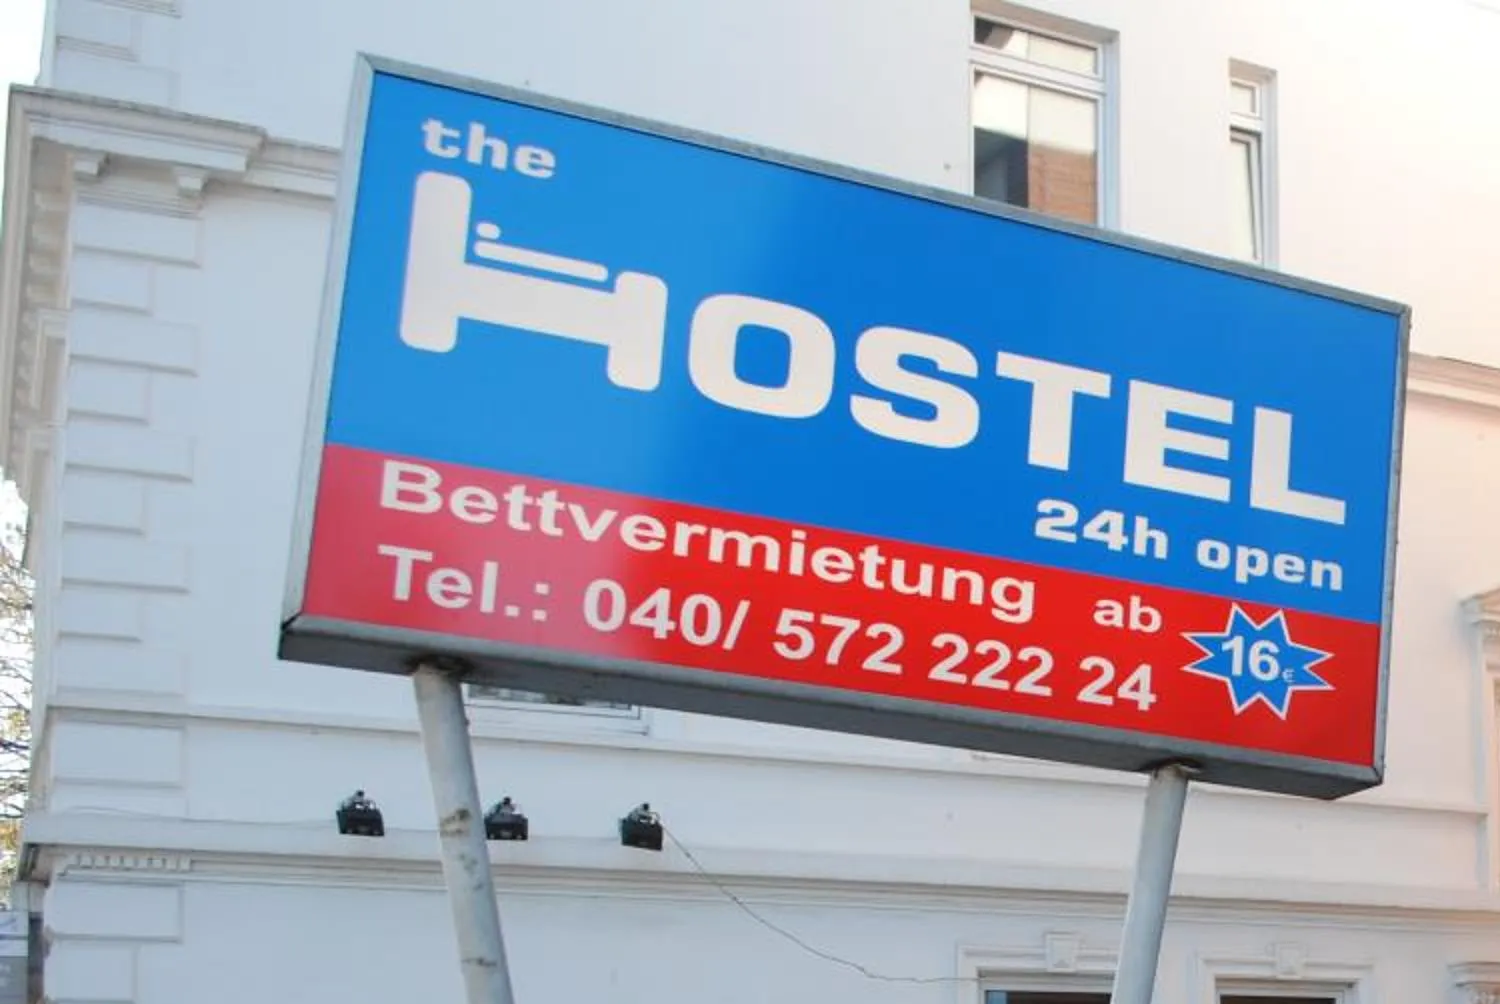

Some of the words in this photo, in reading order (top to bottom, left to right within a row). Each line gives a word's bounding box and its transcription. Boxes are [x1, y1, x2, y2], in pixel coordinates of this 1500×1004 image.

[423, 120, 555, 178] the
[399, 170, 1346, 525] HOSTEL
[378, 544, 550, 622] Tel.:
[583, 578, 750, 650] 040/
[773, 608, 904, 674] 572
[928, 633, 1054, 697] 222
[1077, 656, 1156, 711] 24
[380, 459, 1035, 624] Bettvermietung
[1093, 595, 1163, 633] ab
[1034, 498, 1168, 559] 24h
[1196, 538, 1343, 591] open
